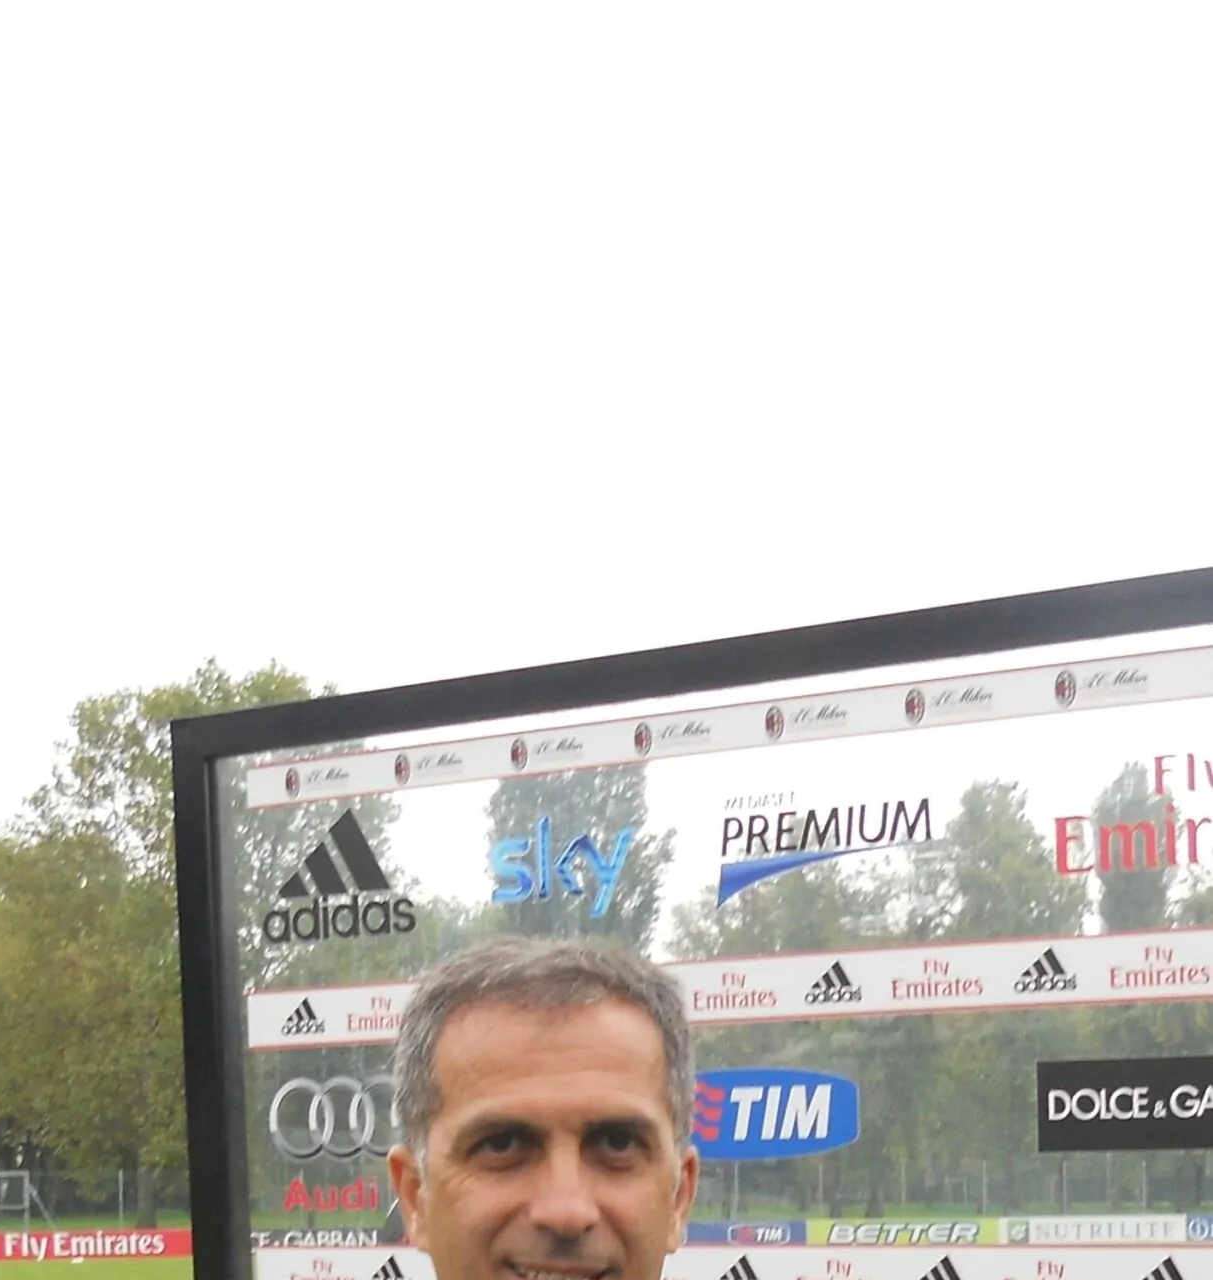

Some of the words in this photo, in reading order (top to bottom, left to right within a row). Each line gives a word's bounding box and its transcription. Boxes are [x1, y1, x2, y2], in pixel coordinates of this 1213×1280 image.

[721, 797, 932, 857] PREMIUM
[492, 816, 633, 918] sky
[263, 895, 416, 943] adidas
[1145, 946, 1173, 964] Fly
[924, 960, 950, 976] Fly
[1110, 963, 1210, 989] Emirates
[722, 972, 747, 989] Fly
[891, 975, 984, 1000] Emirates
[1013, 973, 1078, 994] adidas
[371, 997, 392, 1012] Fly
[693, 987, 777, 1012] Emirates
[804, 986, 863, 1005] adidas
[281, 1019, 325, 1036] adidas
[730, 1083, 832, 1142] TIM
[1048, 1086, 1150, 1121] DOLCE
[284, 1175, 380, 1212] Audi
[756, 1227, 783, 1242] TIM
[828, 1222, 979, 1245] BETTER
[1037, 1222, 1177, 1240] NUTRILITE
[5, 1232, 47, 1261] Fly
[53, 1230, 165, 1257] Emirates
[313, 1260, 333, 1273] Fly
[827, 1260, 851, 1276] Fly
[1037, 1261, 1064, 1278] Fly
